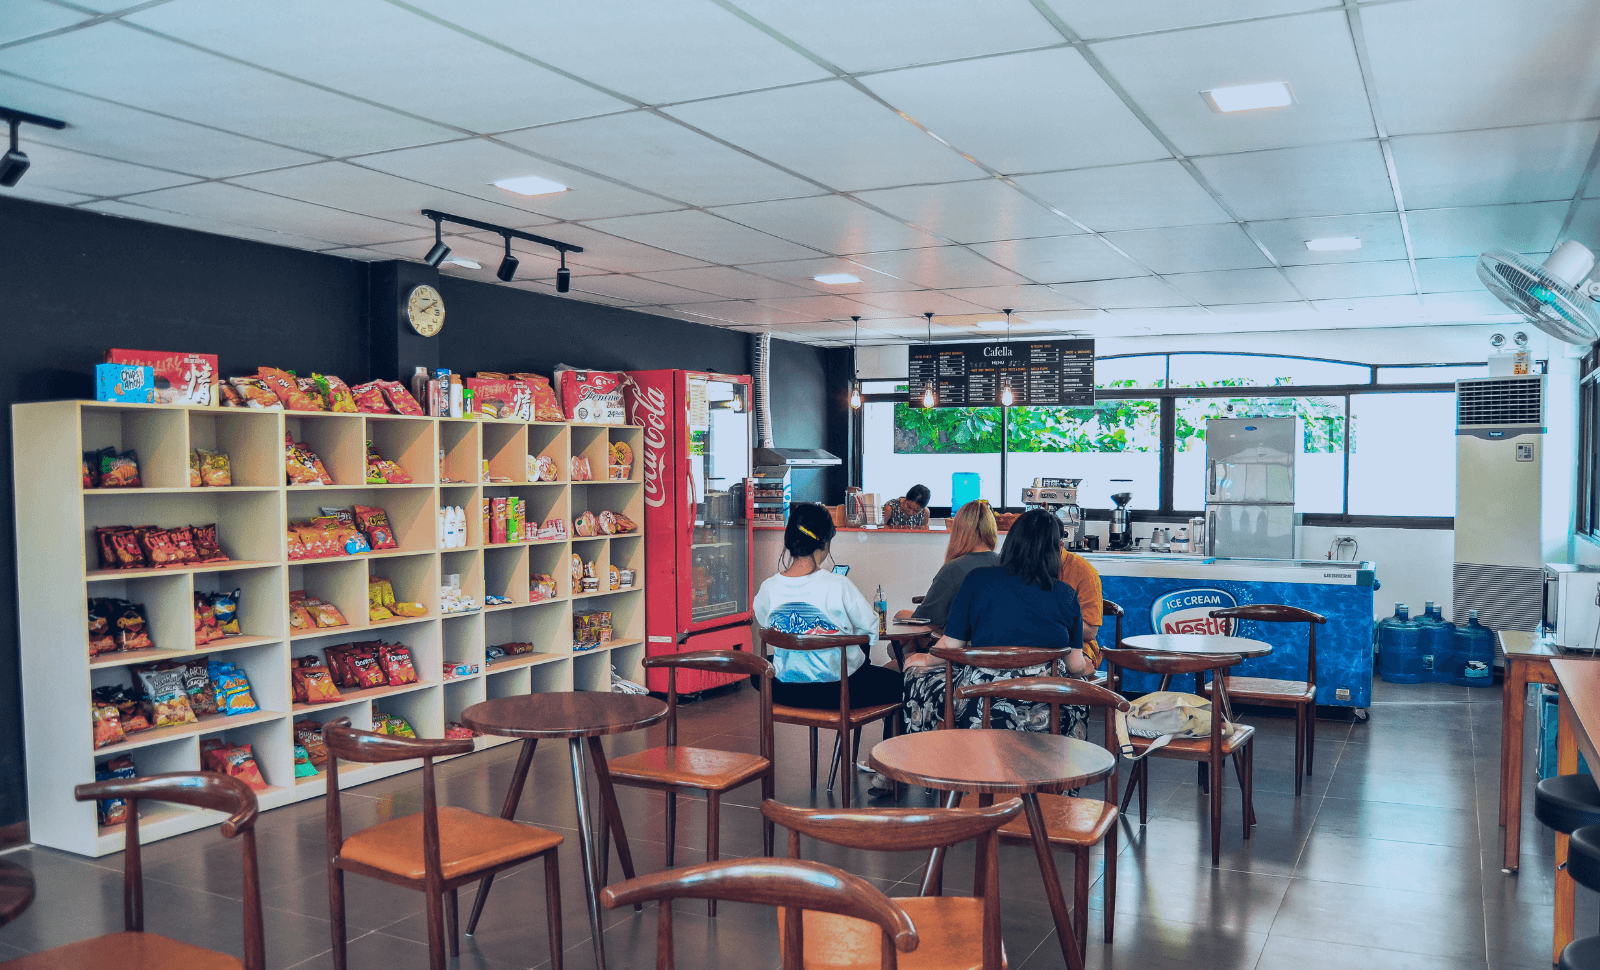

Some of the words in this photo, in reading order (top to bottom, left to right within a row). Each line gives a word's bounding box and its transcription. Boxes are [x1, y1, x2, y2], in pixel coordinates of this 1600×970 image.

[983, 346, 1013, 357] Cafella
[121, 370, 140, 382] Chips
[1166, 598, 1183, 610] ICE
[1183, 595, 1221, 606] CREAM
